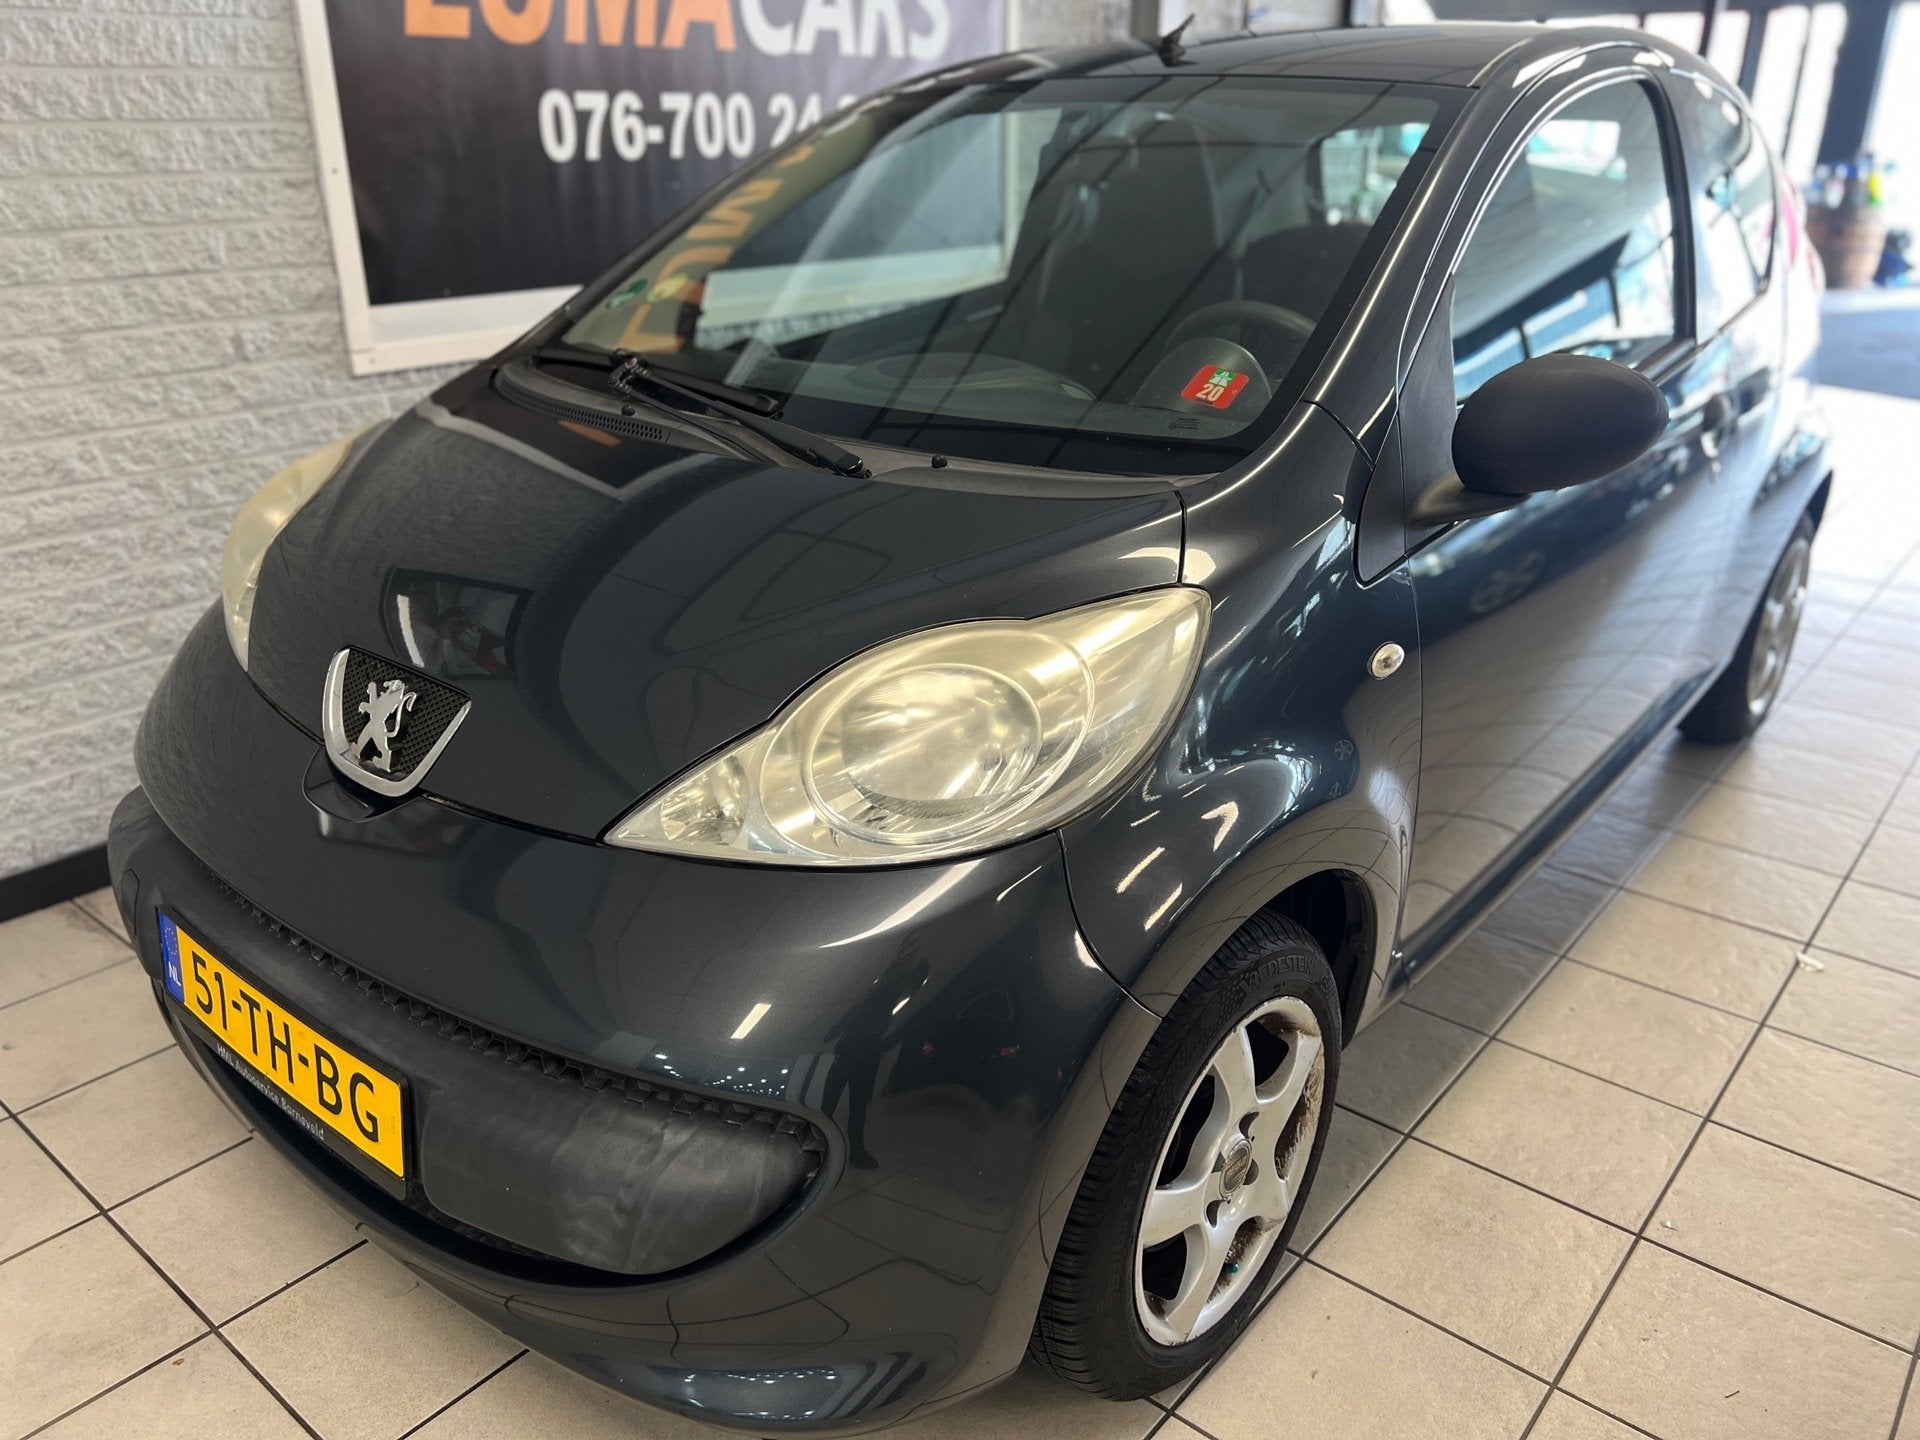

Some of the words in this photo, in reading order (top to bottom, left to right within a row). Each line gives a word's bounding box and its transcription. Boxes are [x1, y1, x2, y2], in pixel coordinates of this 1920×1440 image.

[538, 89, 756, 163] 076-700
[1195, 383, 1225, 401] 20
[168, 961, 181, 987] NL
[191, 950, 379, 1143] 51-TH-BG
[235, 1060, 280, 1104] Autoservice
[281, 1096, 325, 1141] Barneveld
